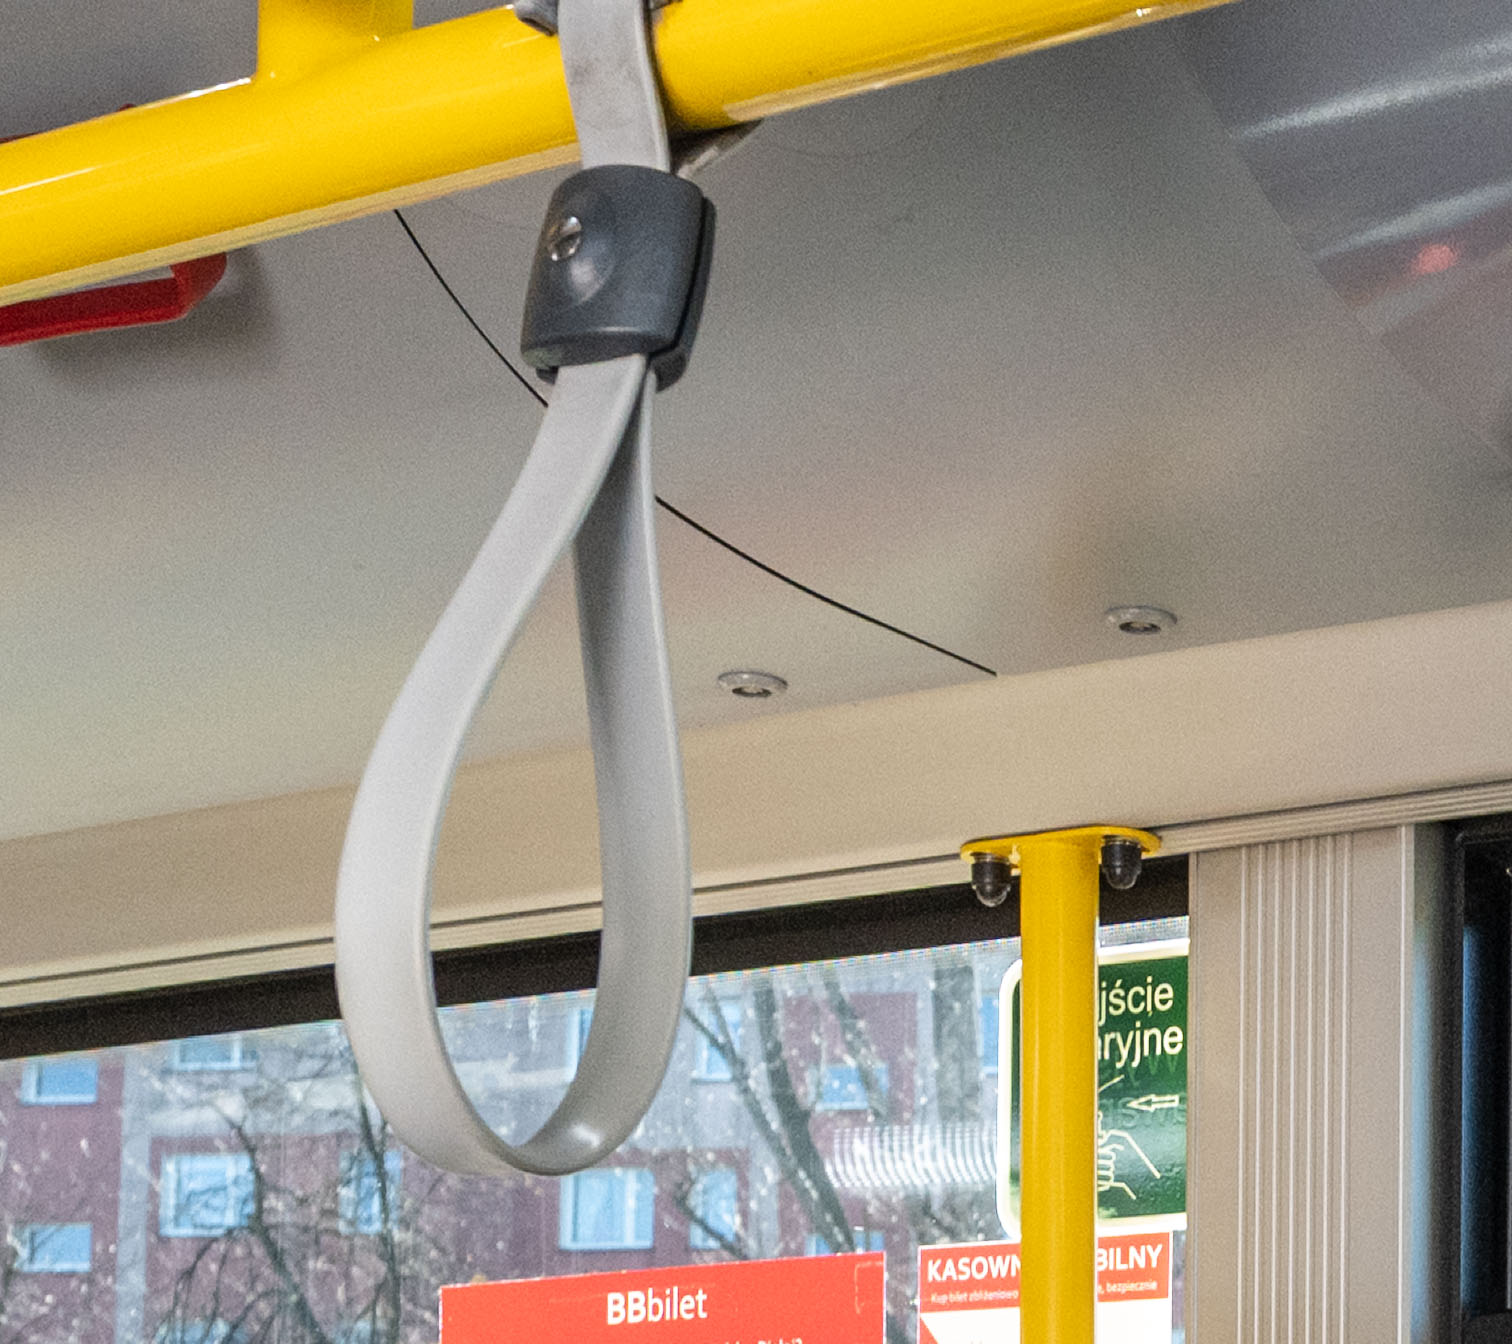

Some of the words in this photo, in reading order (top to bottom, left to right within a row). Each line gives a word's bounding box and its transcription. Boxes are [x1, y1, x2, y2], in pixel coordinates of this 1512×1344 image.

[1098, 975, 1174, 1026] jście
[1097, 1020, 1184, 1069] ryjne
[928, 1253, 1021, 1283] KASOWN
[1096, 1243, 1163, 1271] BILNY
[606, 1287, 708, 1326] BBbilet
